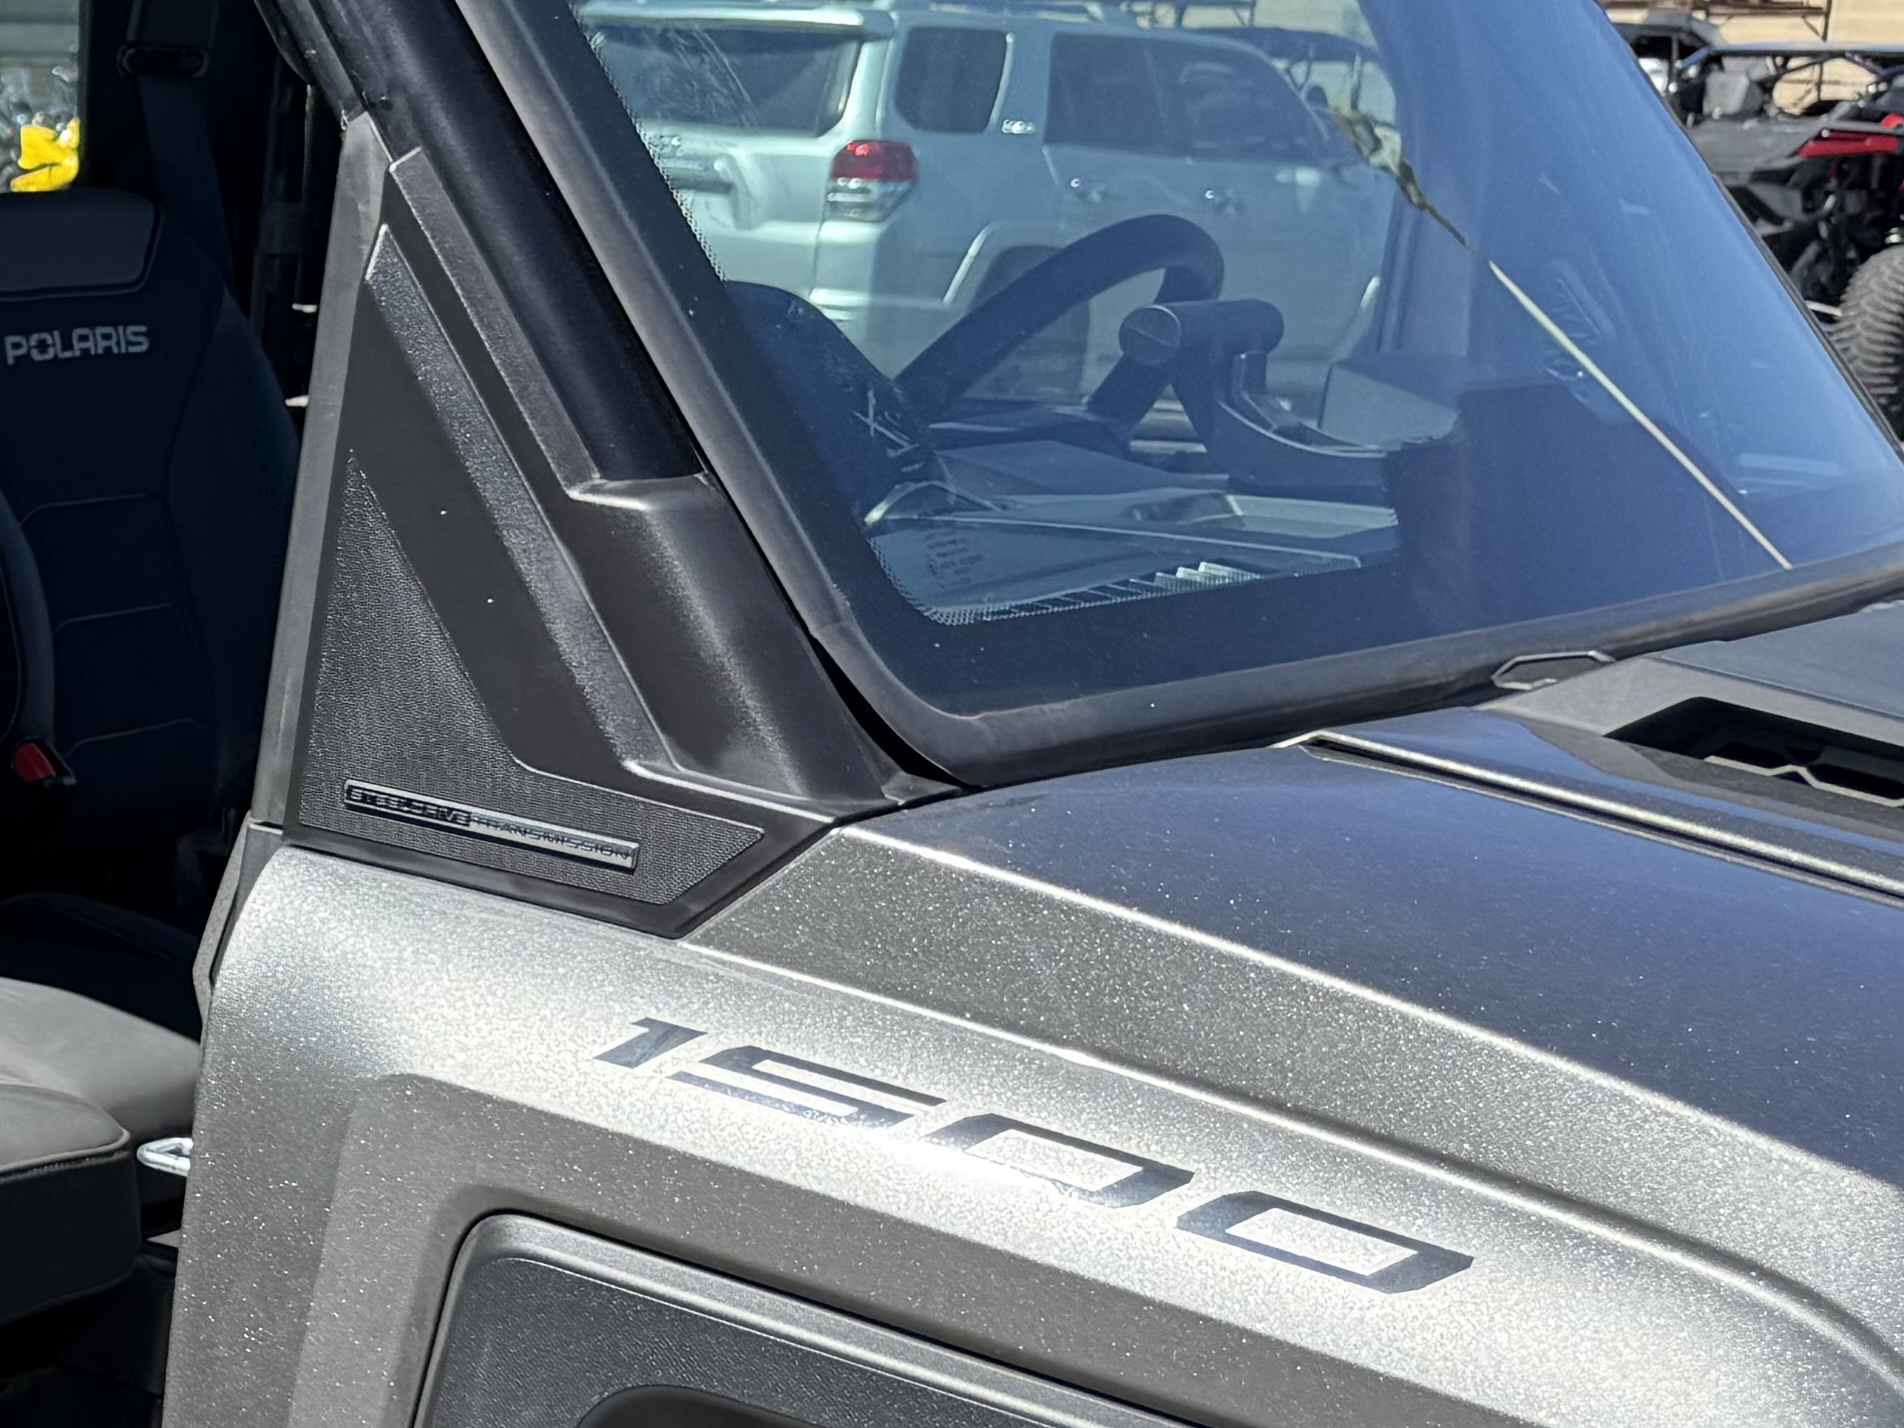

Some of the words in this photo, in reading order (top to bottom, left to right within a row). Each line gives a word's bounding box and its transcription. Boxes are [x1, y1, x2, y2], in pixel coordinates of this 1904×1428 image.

[4, 324, 150, 366] POLARIS
[471, 811, 633, 860] TRANSMISSION
[592, 1016, 1475, 1295] 1500
